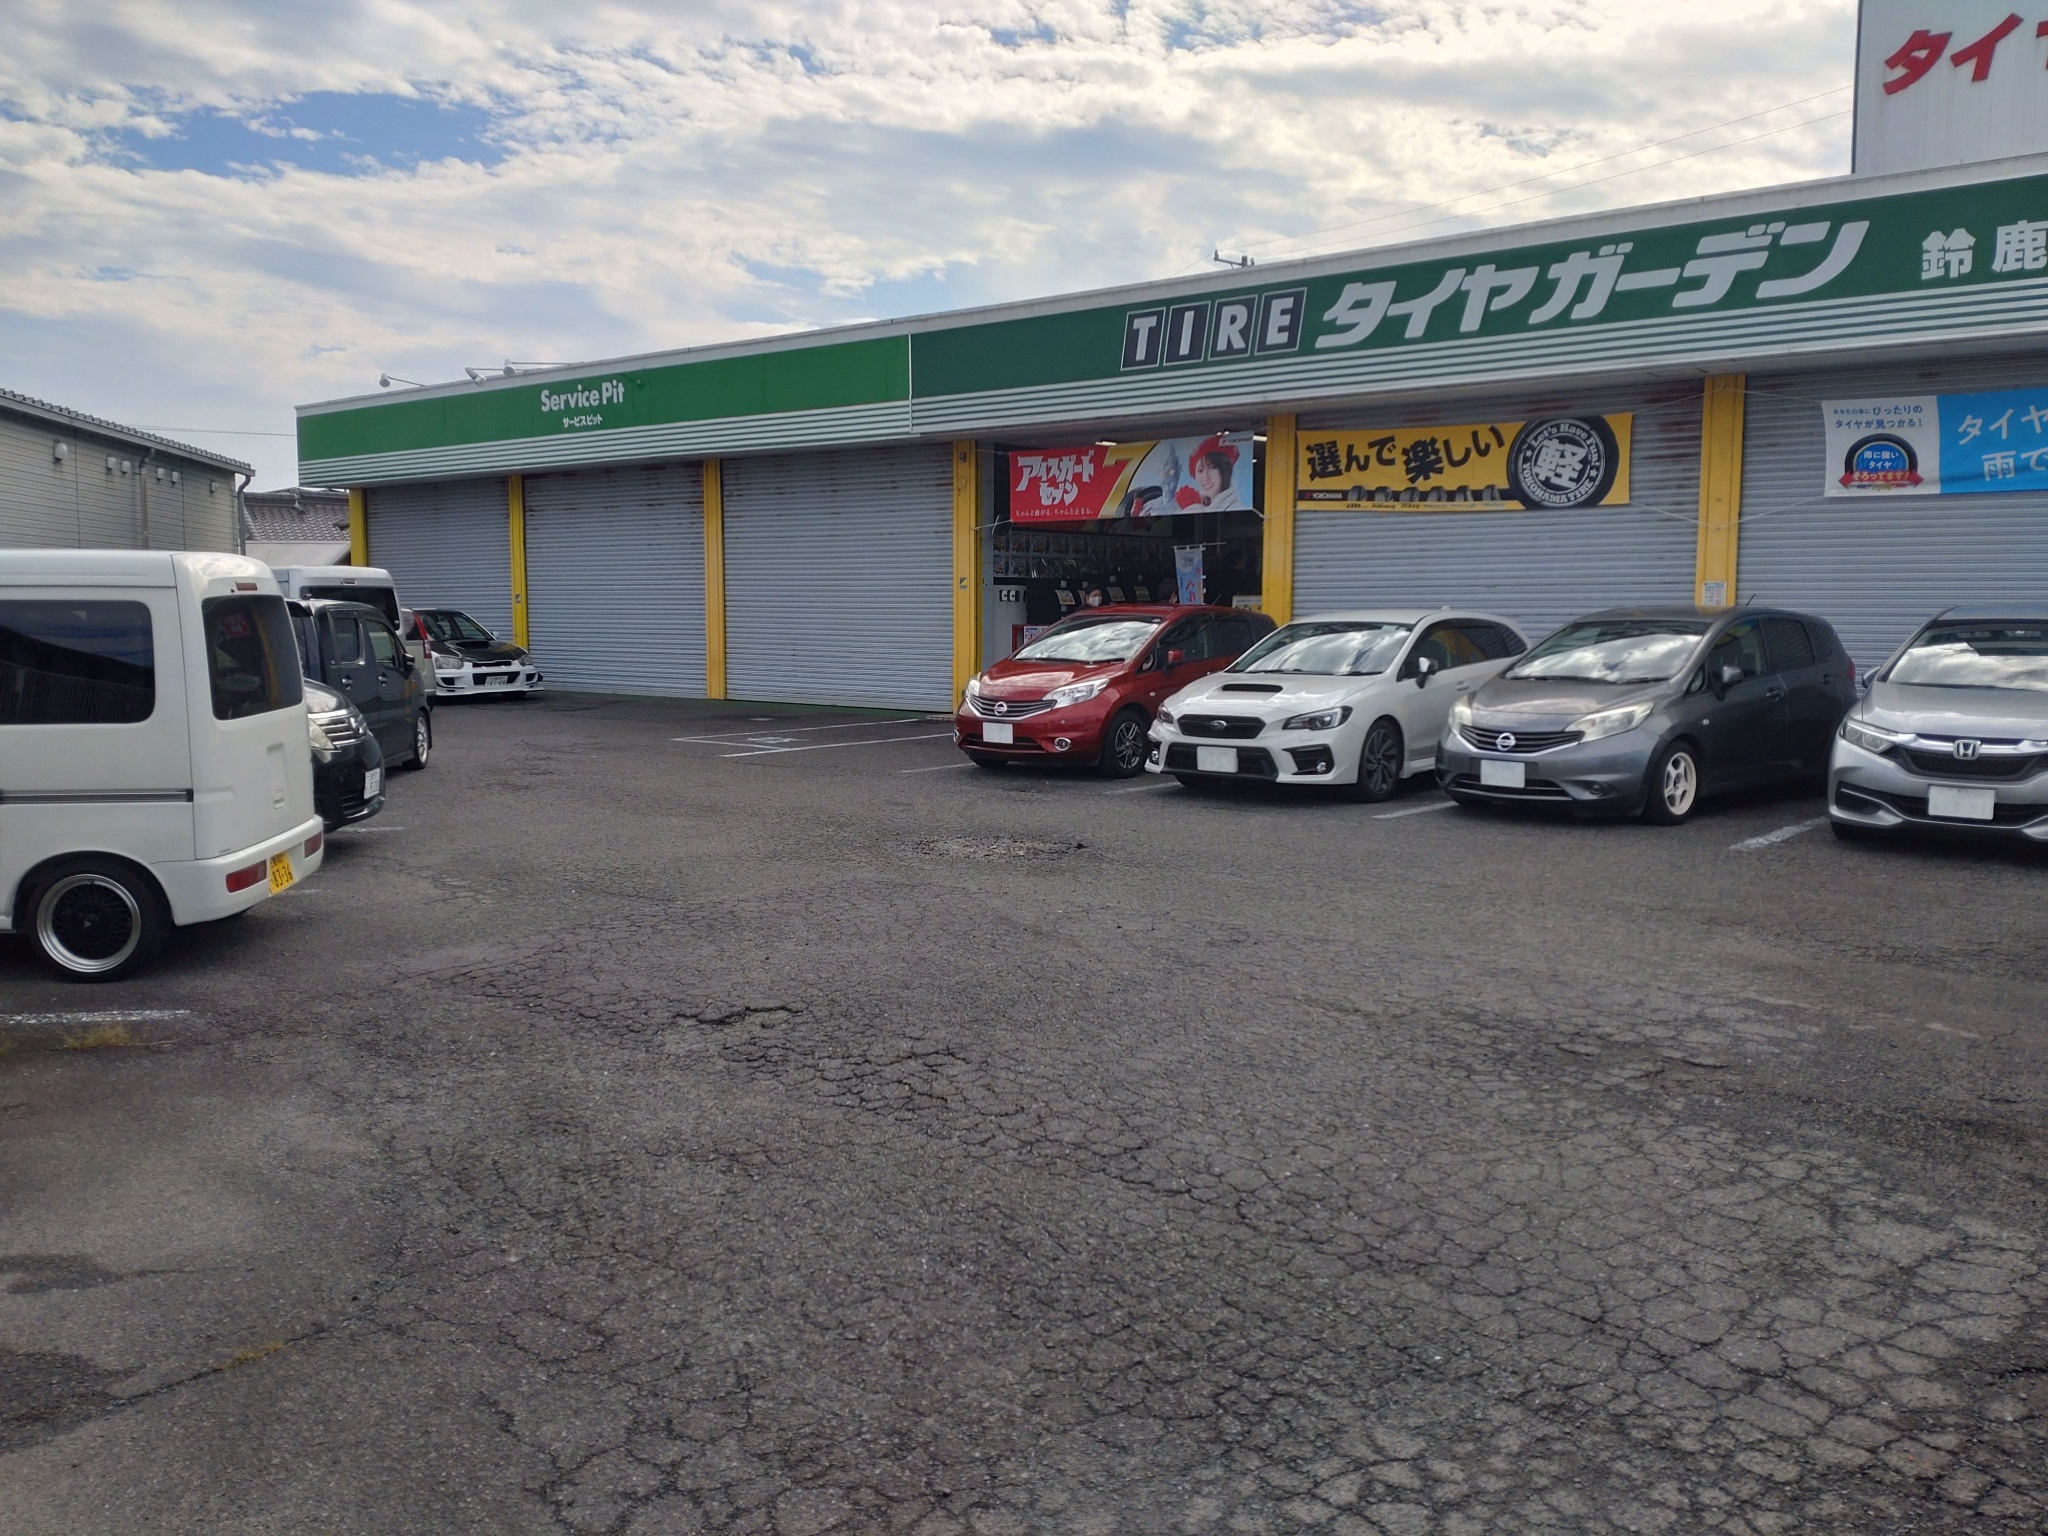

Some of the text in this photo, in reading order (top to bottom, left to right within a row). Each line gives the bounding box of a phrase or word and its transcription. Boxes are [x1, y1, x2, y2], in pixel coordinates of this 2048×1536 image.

[1883, 13, 2048, 95] タイ
[1921, 219, 2048, 281] 鈴鹿
[1314, 220, 1870, 349] タイヤガーデン
[1130, 299, 1295, 364] TIRE
[541, 379, 625, 412] Service Pit
[563, 413, 603, 428] サービスピット
[1305, 425, 1506, 483] 選んで楽しい
[1531, 423, 1601, 466] Let's Have Fun!
[1533, 438, 1588, 489] 軽
[1868, 461, 1892, 469] タイヤ
[1015, 450, 1095, 491] アイスガード
[1523, 462, 1594, 503] YOKOHAMA TIRE
[1039, 480, 1079, 506] セブン
